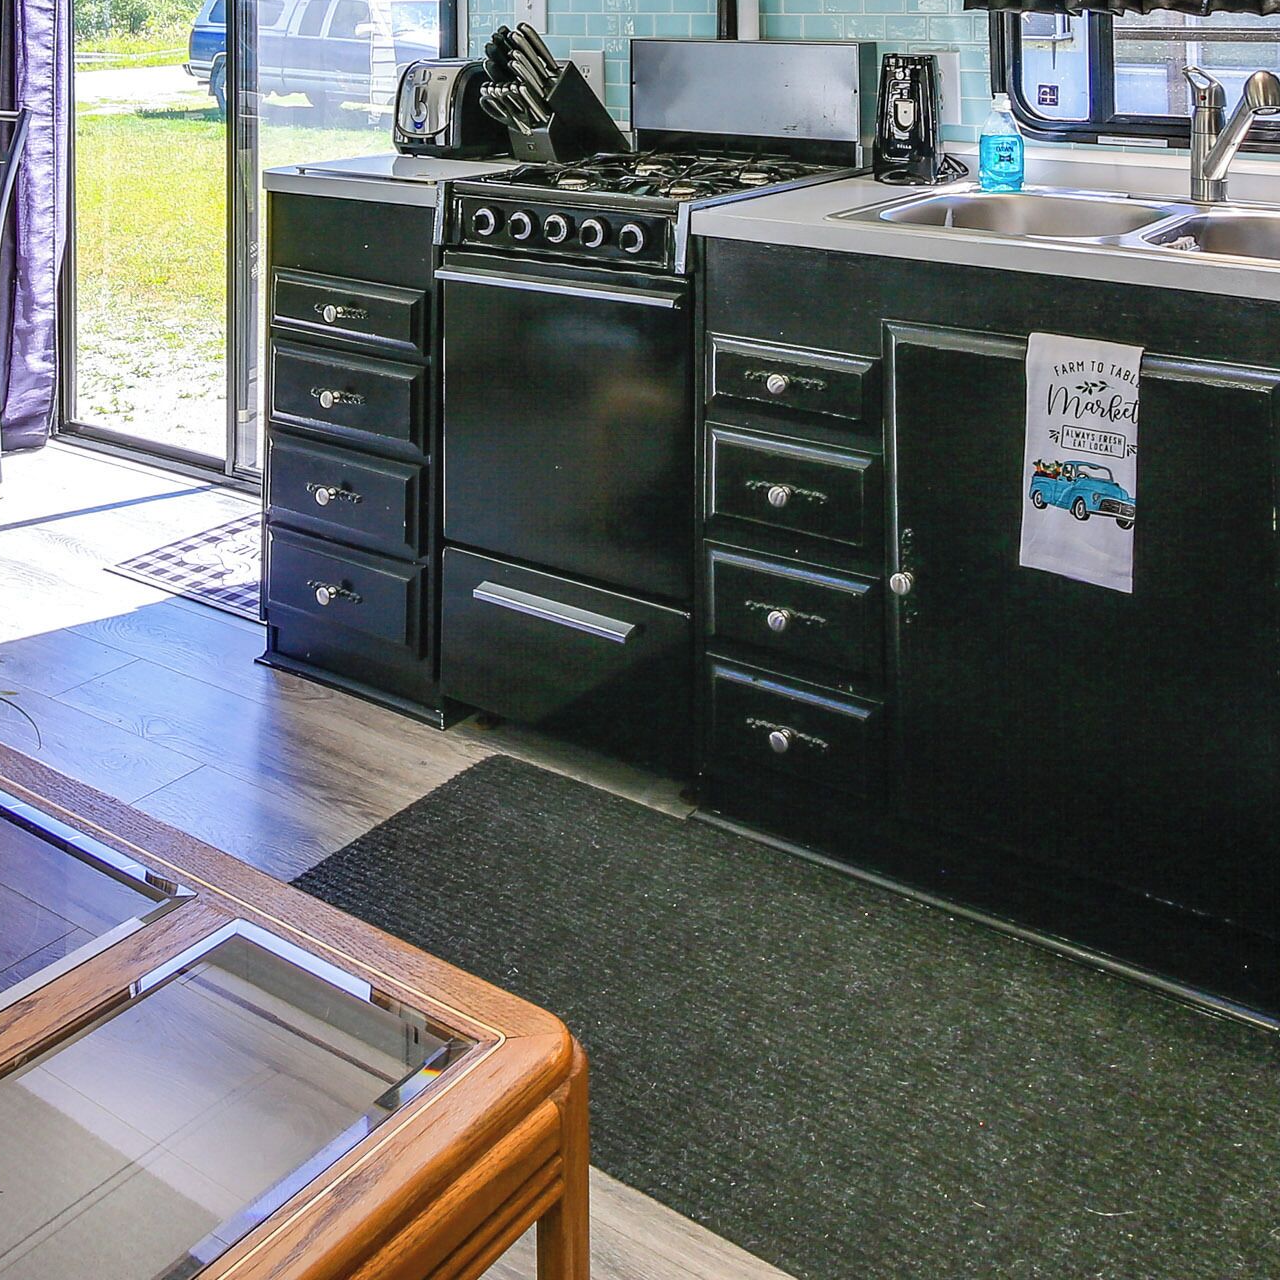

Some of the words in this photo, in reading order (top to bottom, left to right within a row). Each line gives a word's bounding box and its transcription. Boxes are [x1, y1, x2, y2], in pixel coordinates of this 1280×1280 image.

[1054, 361, 1085, 376] FARM
[1091, 361, 1104, 373] TO
[1047, 384, 1140, 424] Market
[1065, 429, 1095, 441] ALWAYS
[1098, 435, 1123, 446] FRESH
[1073, 439, 1086, 448] EAT
[1089, 442, 1114, 453] LOCAL
